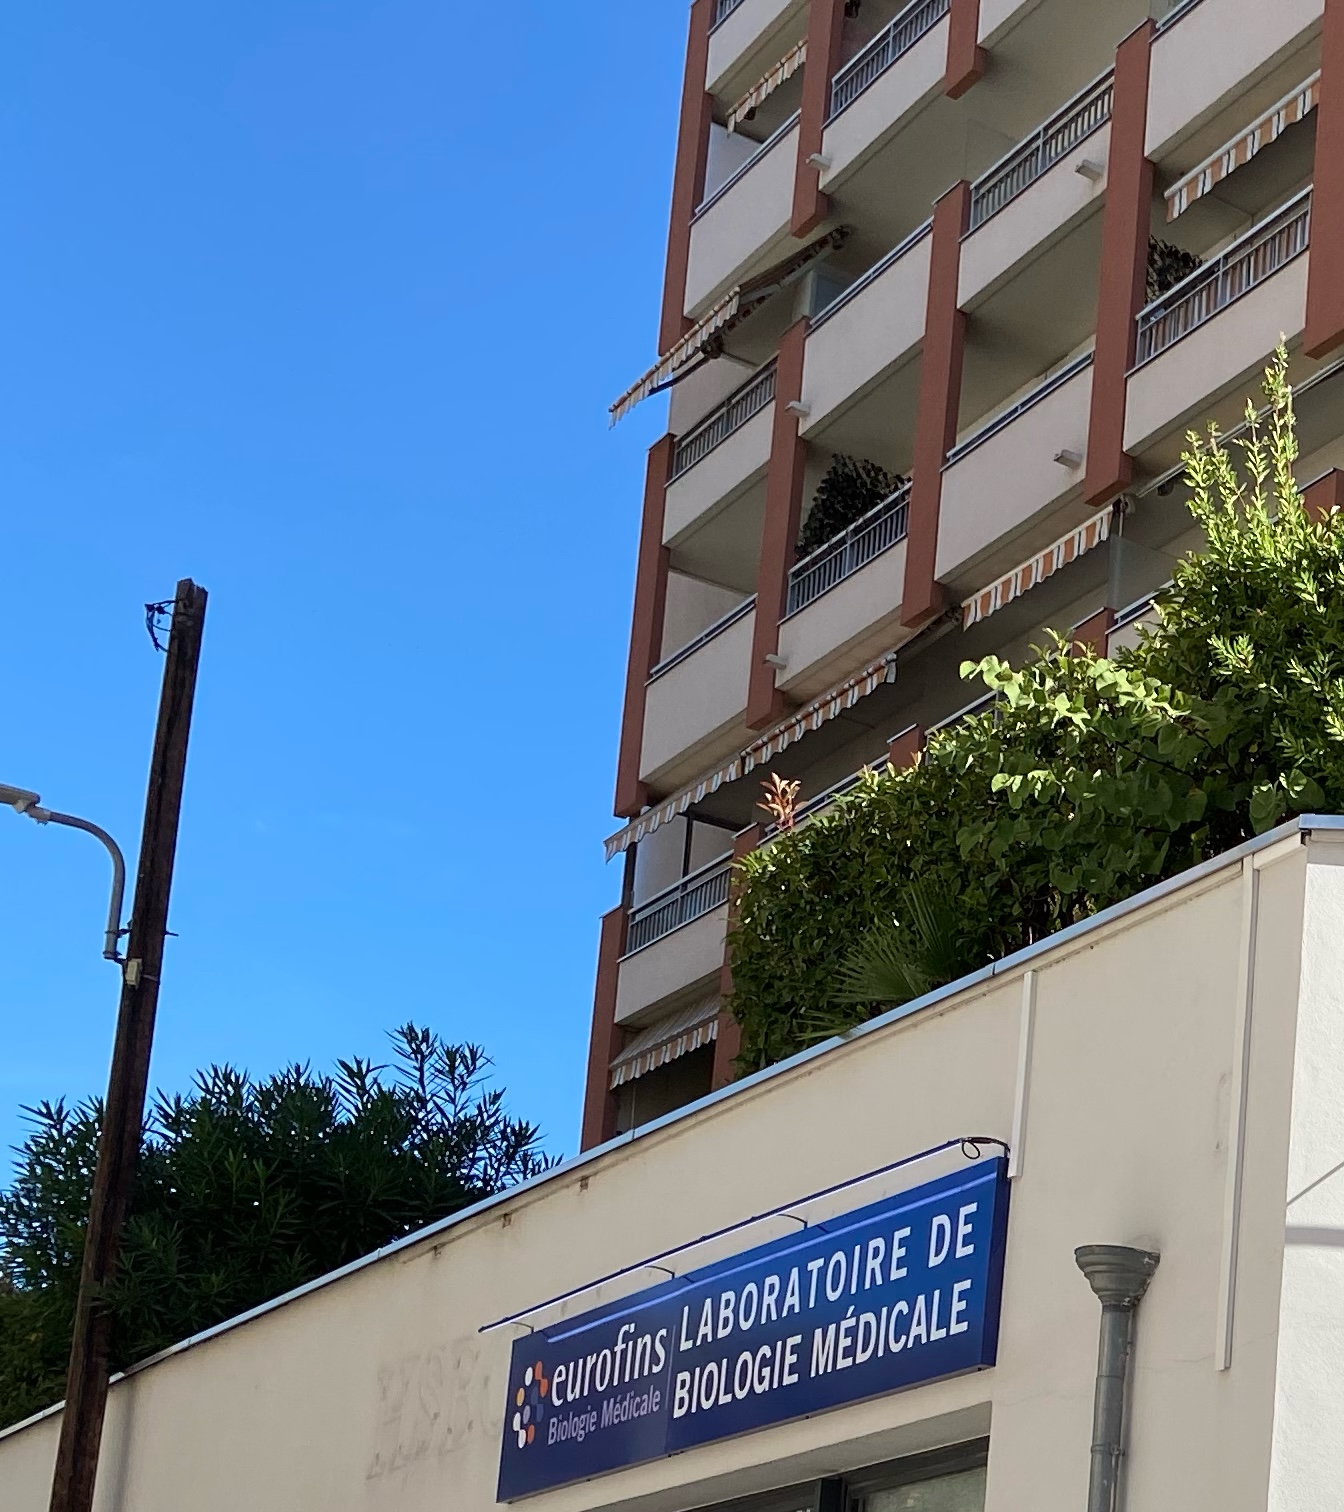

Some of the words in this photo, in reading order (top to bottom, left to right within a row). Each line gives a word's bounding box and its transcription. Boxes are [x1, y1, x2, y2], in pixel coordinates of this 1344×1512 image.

[679, 1226, 912, 1352] LABORATOIRE
[927, 1201, 979, 1269] DE
[551, 1322, 669, 1407] eurofins
[672, 1333, 803, 1419] BIOLOGIE
[809, 1278, 972, 1378] MÉDICALE
[547, 1406, 598, 1446] Biologie
[600, 1384, 662, 1430] Médicale
